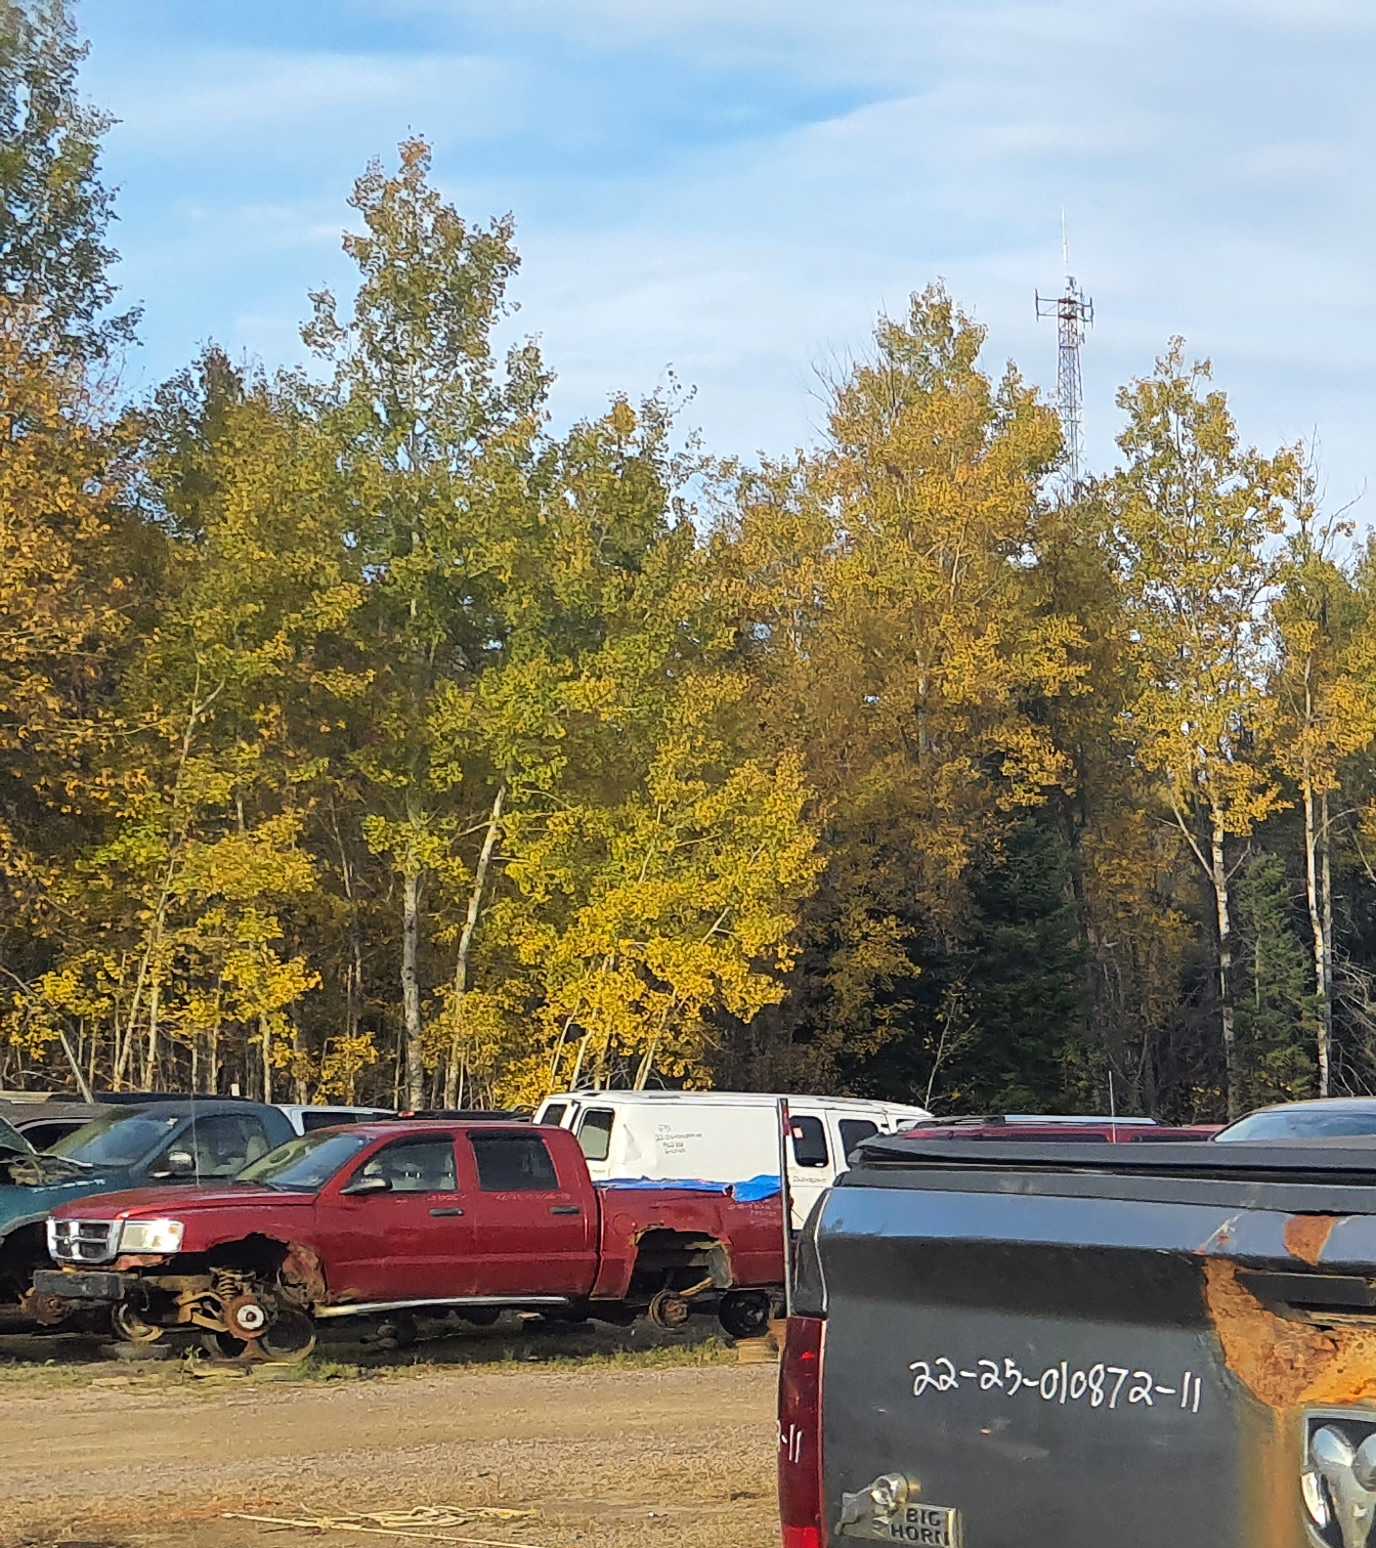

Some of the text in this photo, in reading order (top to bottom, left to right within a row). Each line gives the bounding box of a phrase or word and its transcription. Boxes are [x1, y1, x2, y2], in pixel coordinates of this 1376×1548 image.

[907, 1356, 1203, 1414] 22-25-010872-11
[905, 1507, 941, 1527] BIG
[890, 1523, 950, 1547] HORN
